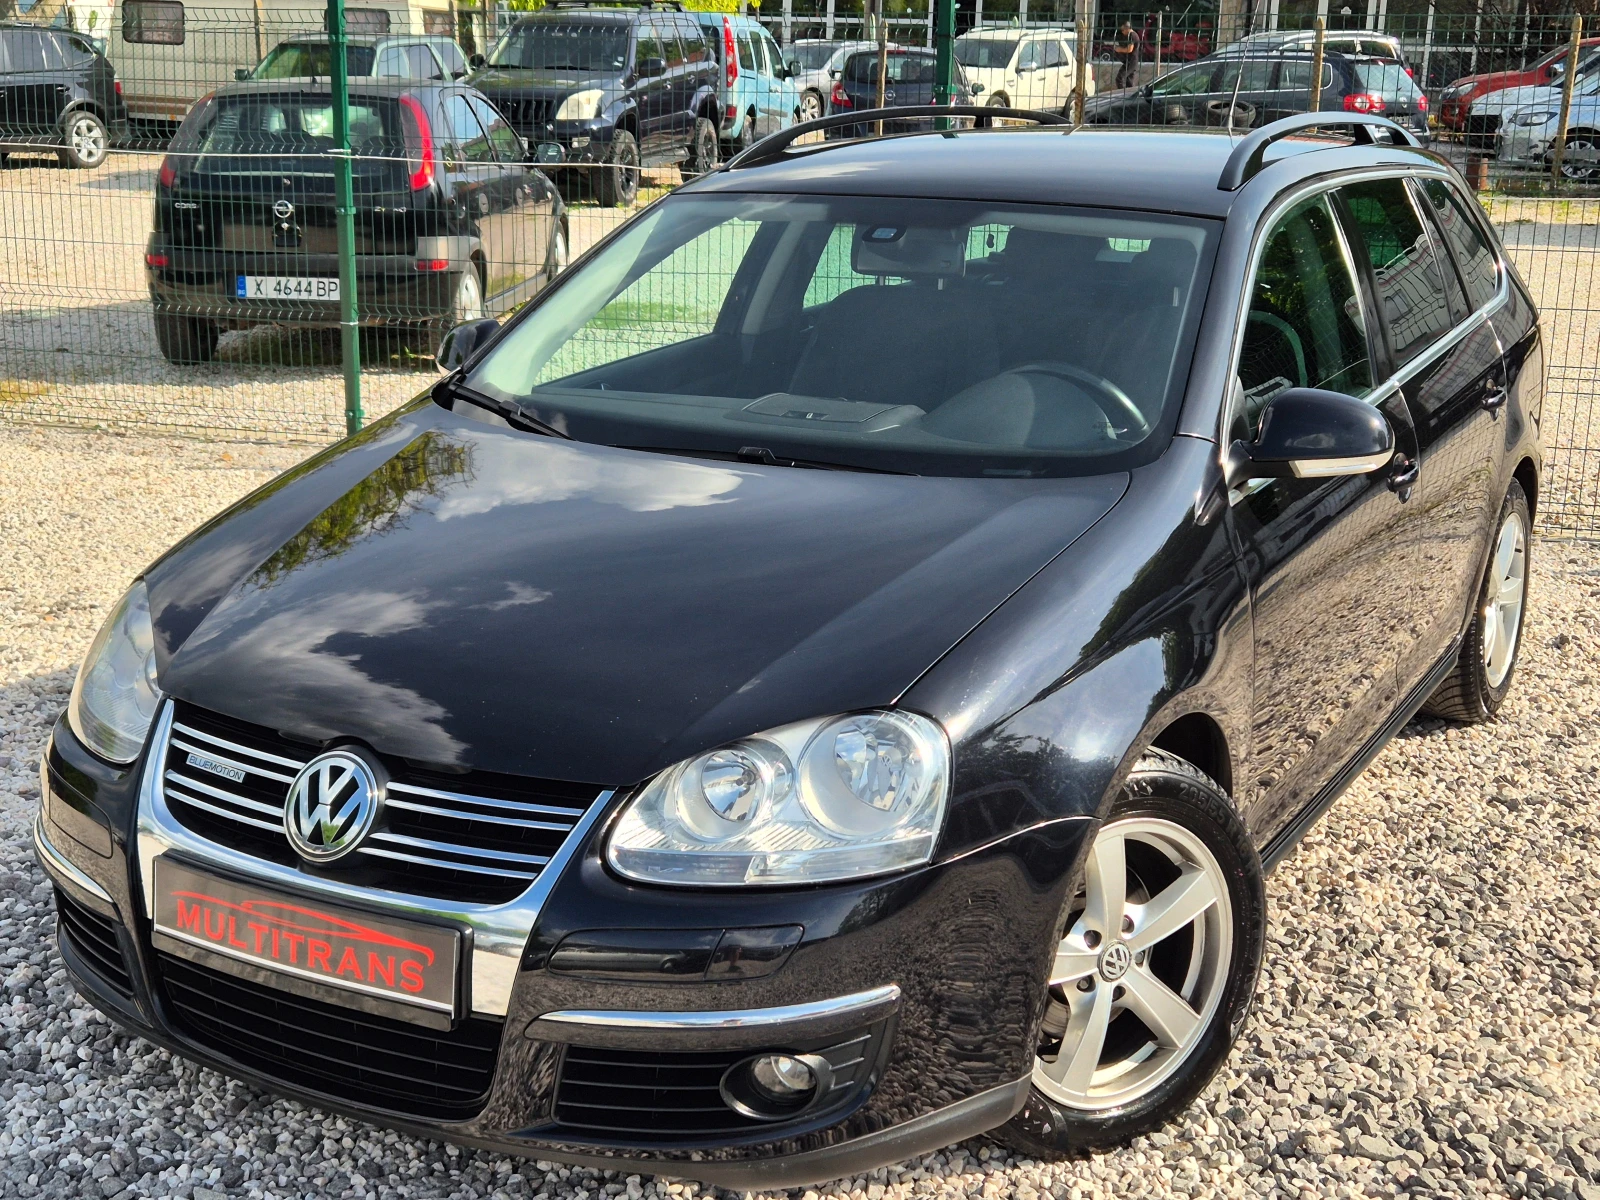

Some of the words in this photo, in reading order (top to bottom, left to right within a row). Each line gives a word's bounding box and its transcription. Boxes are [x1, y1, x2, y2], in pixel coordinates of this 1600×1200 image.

[273, 279, 312, 296] 4644
[189, 755, 243, 780] BLUEMOTION
[1179, 782, 1226, 825] 205/55
[176, 899, 425, 993] MULTITRANS
